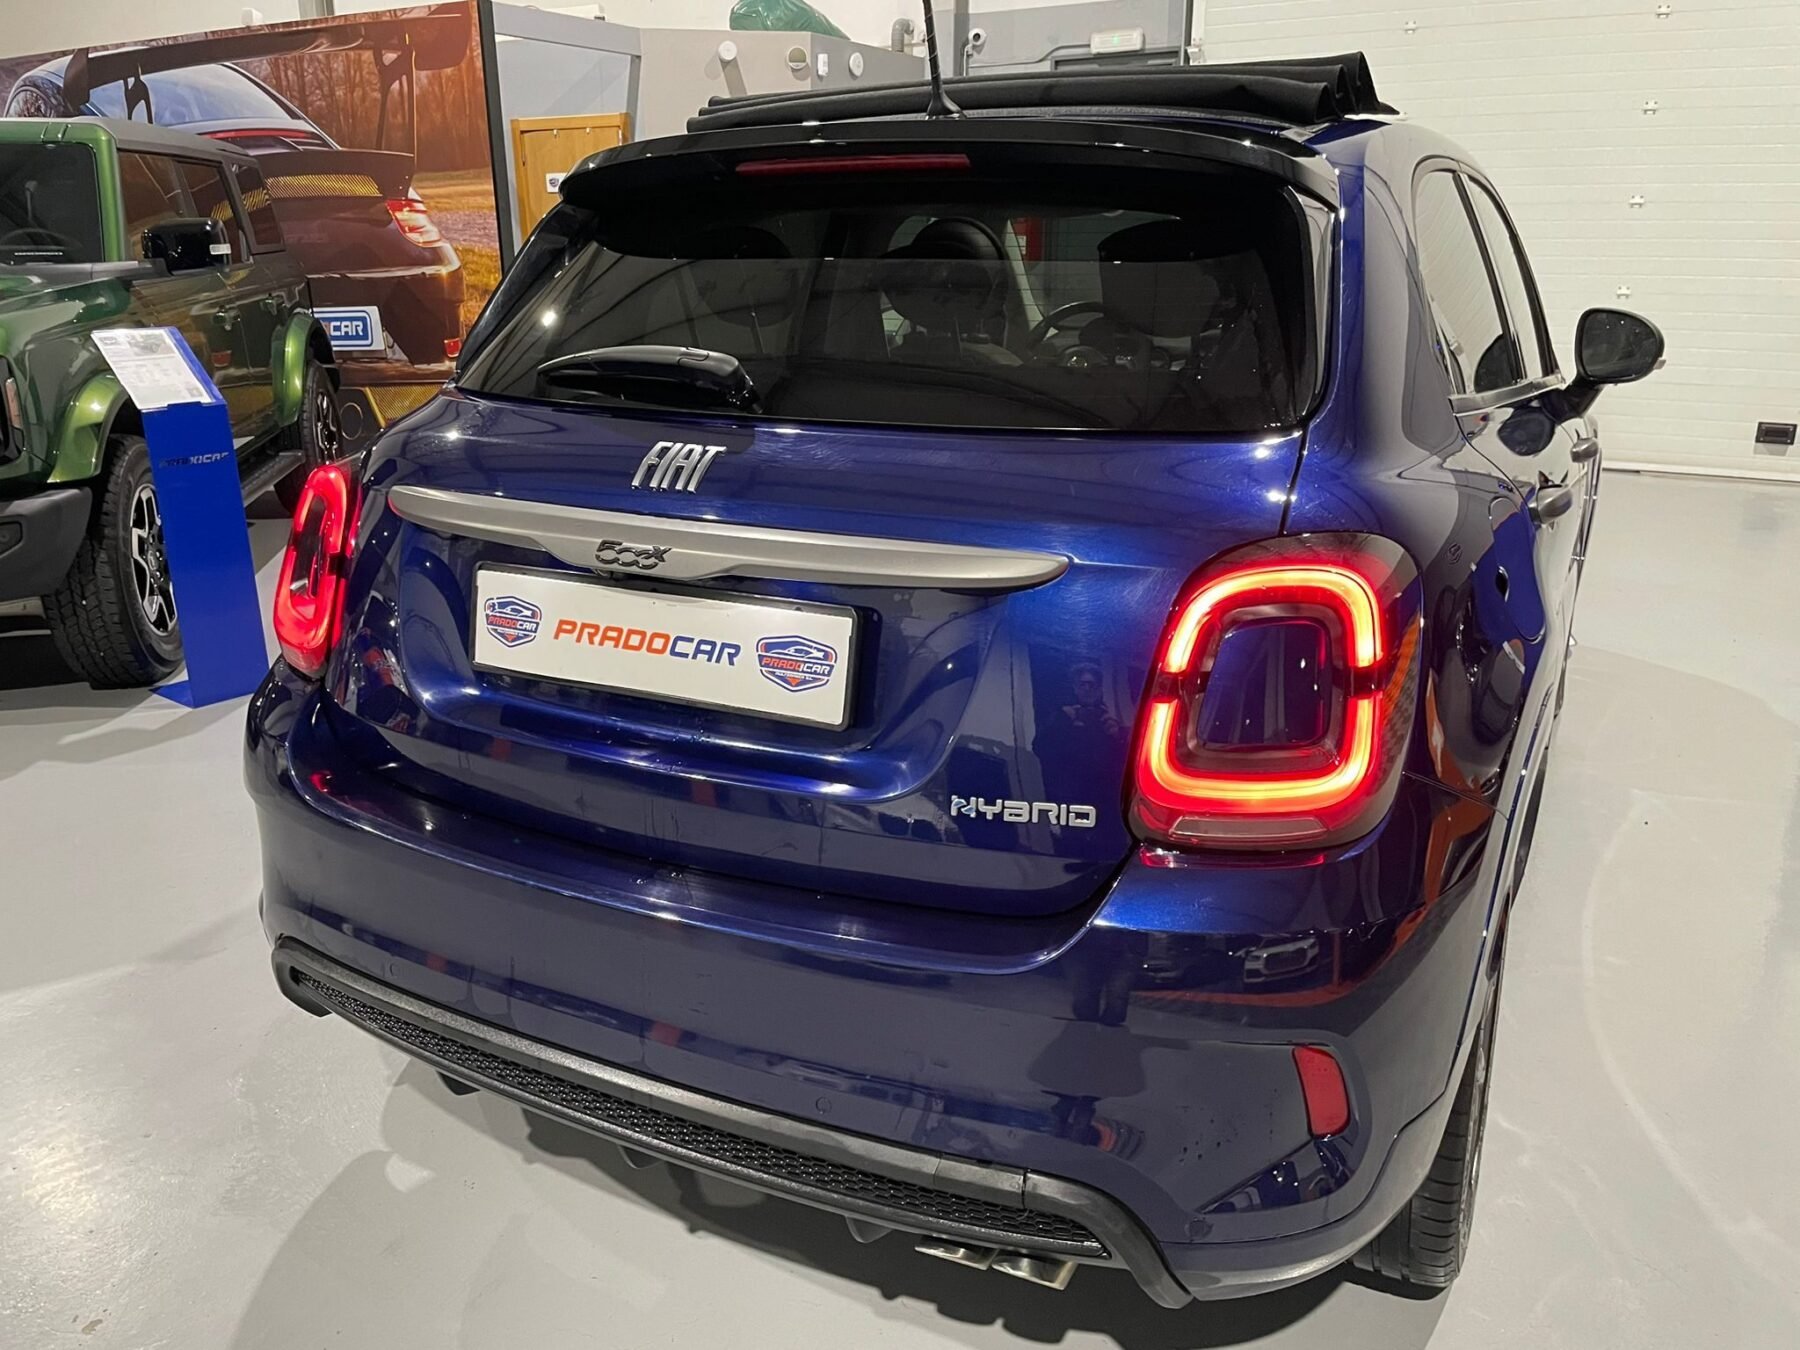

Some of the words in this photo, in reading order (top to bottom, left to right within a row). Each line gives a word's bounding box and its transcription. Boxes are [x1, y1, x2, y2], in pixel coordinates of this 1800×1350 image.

[631, 441, 727, 493] FIAT
[488, 616, 537, 631] PRADOCAR
[553, 619, 741, 666] PRADOCAR
[761, 657, 831, 675] PRADOCAR
[951, 795, 1096, 828] HYBRID
